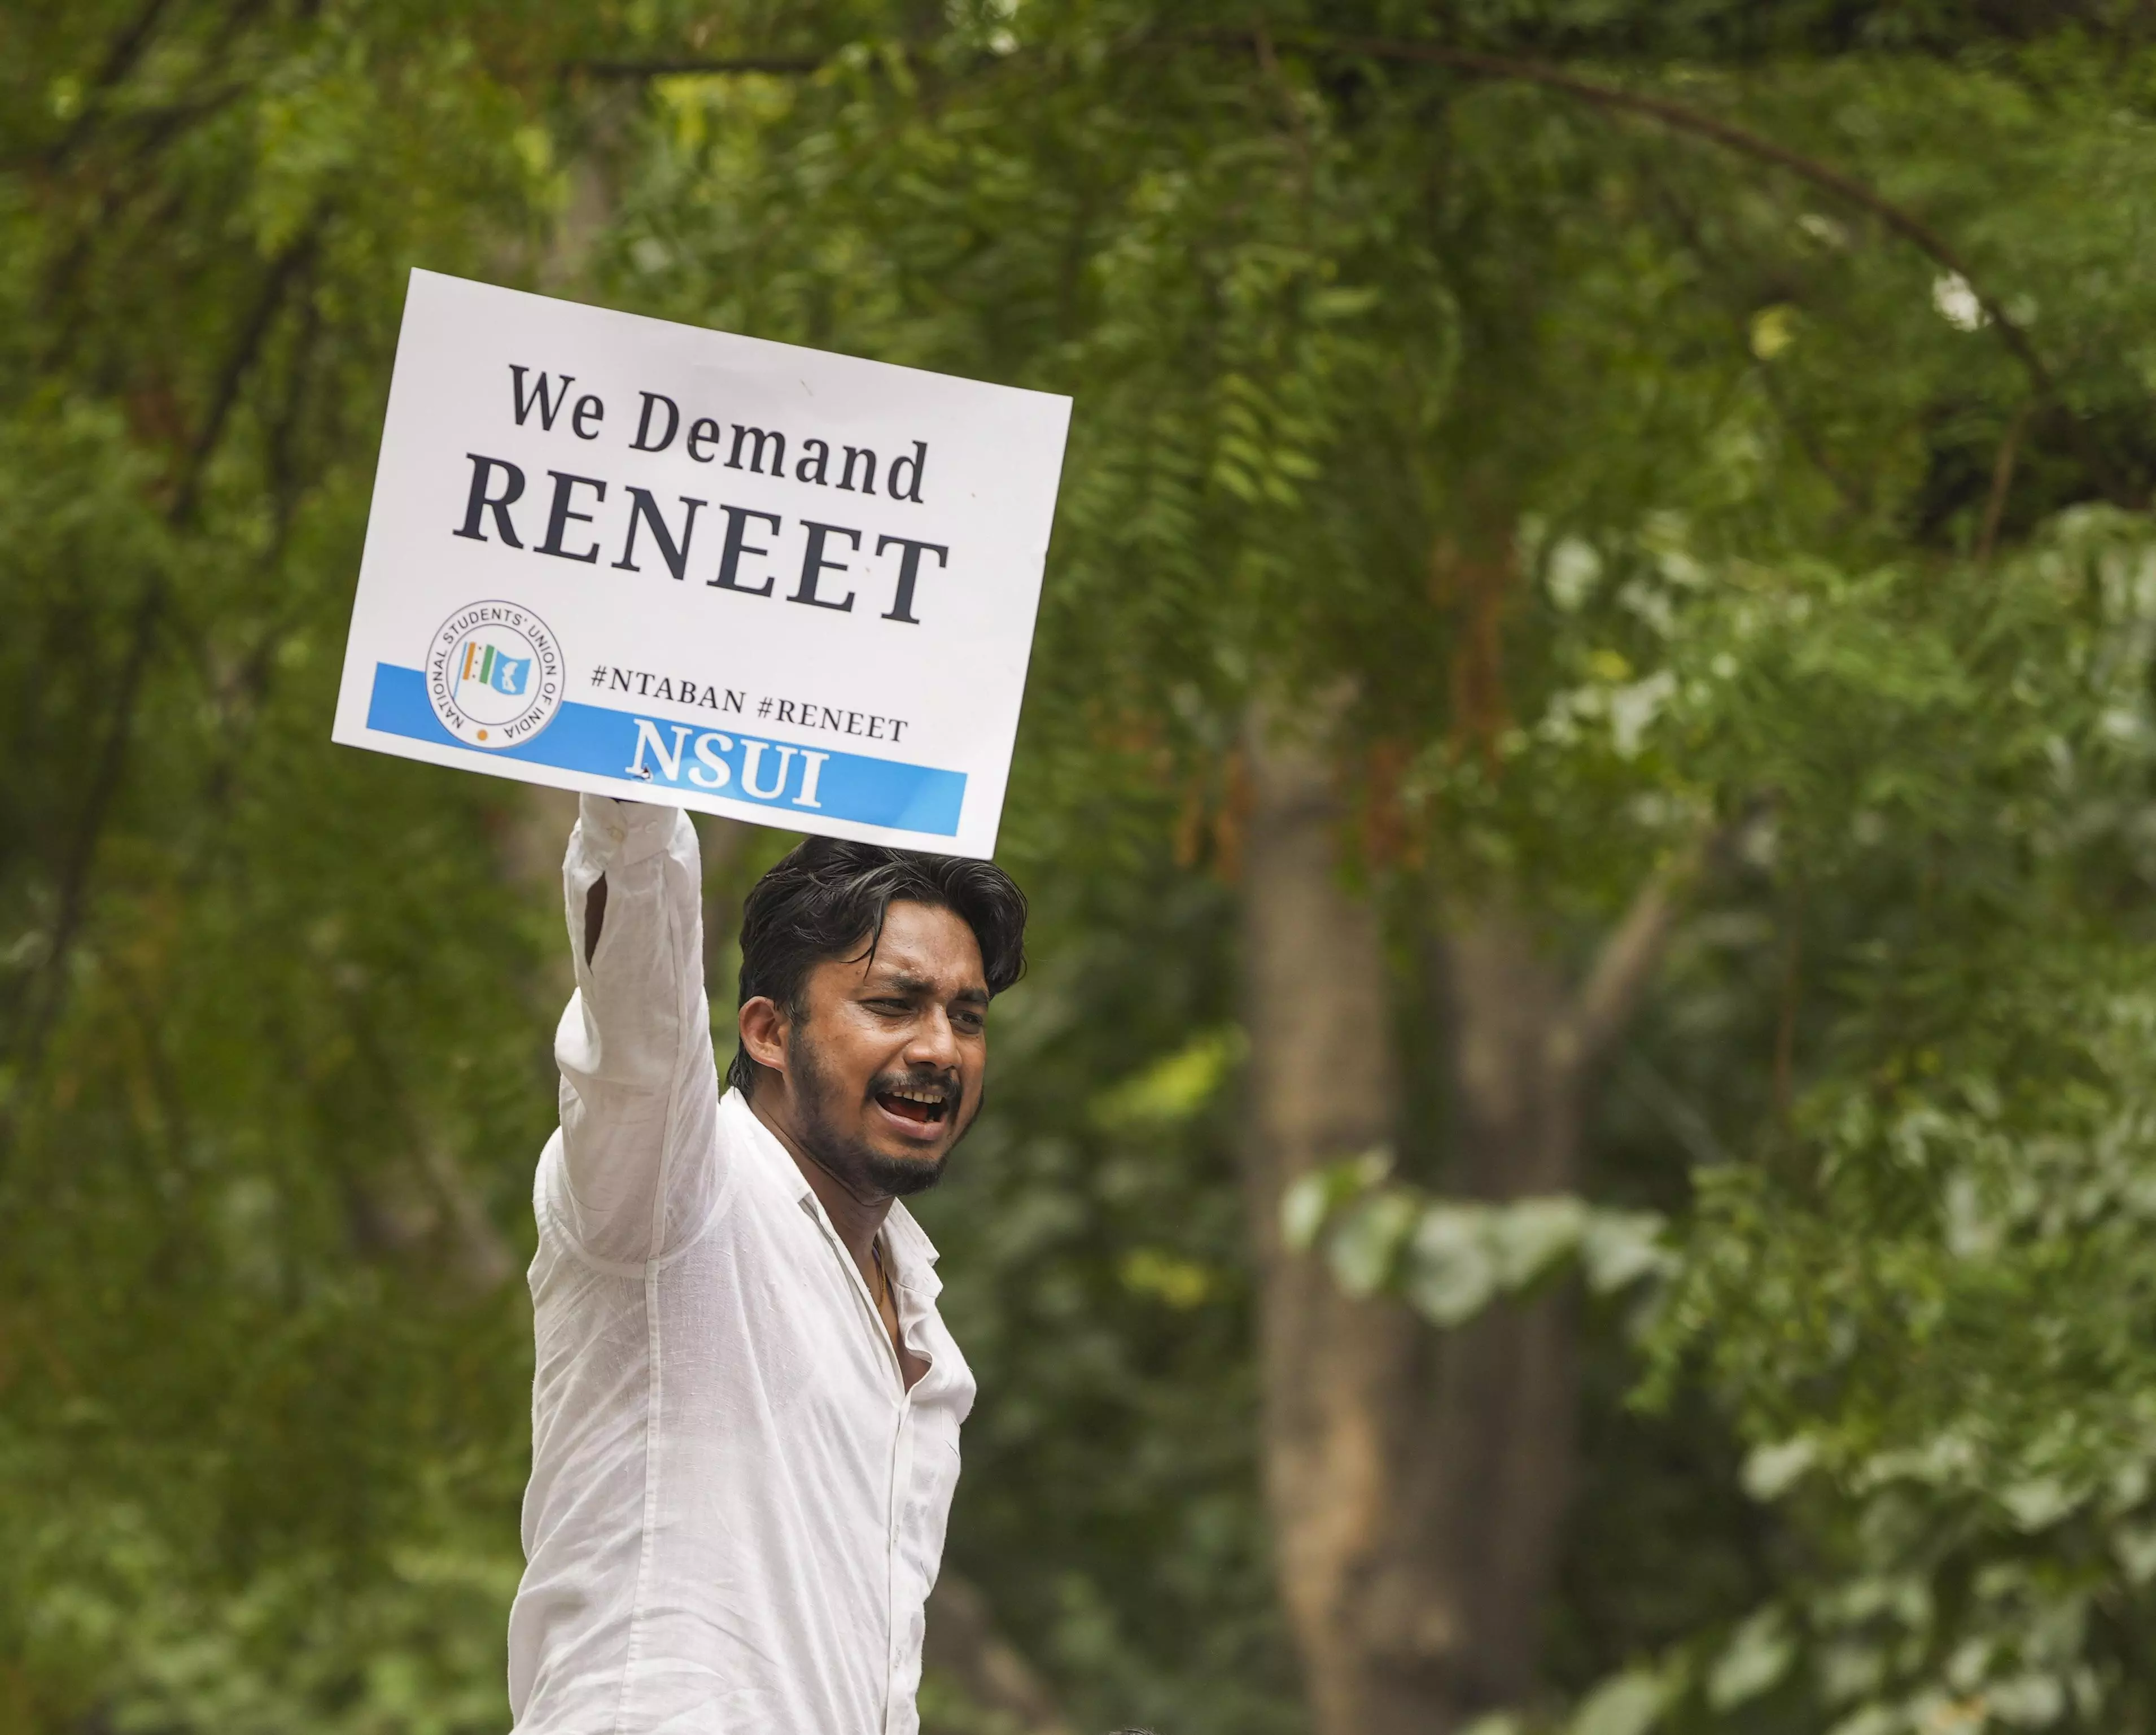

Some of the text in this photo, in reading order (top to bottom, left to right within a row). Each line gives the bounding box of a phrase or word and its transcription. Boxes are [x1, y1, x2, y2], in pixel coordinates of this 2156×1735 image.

[509, 364, 928, 504] We Demand
[452, 452, 949, 625] RENEET
[528, 624, 557, 675] UNION
[432, 650, 465, 729] NATIONAL
[504, 707, 545, 738] INDIA
[541, 683, 556, 706] OF
[591, 665, 909, 743] #NTABAN #RENEET
[625, 718, 830, 808] NSUI
